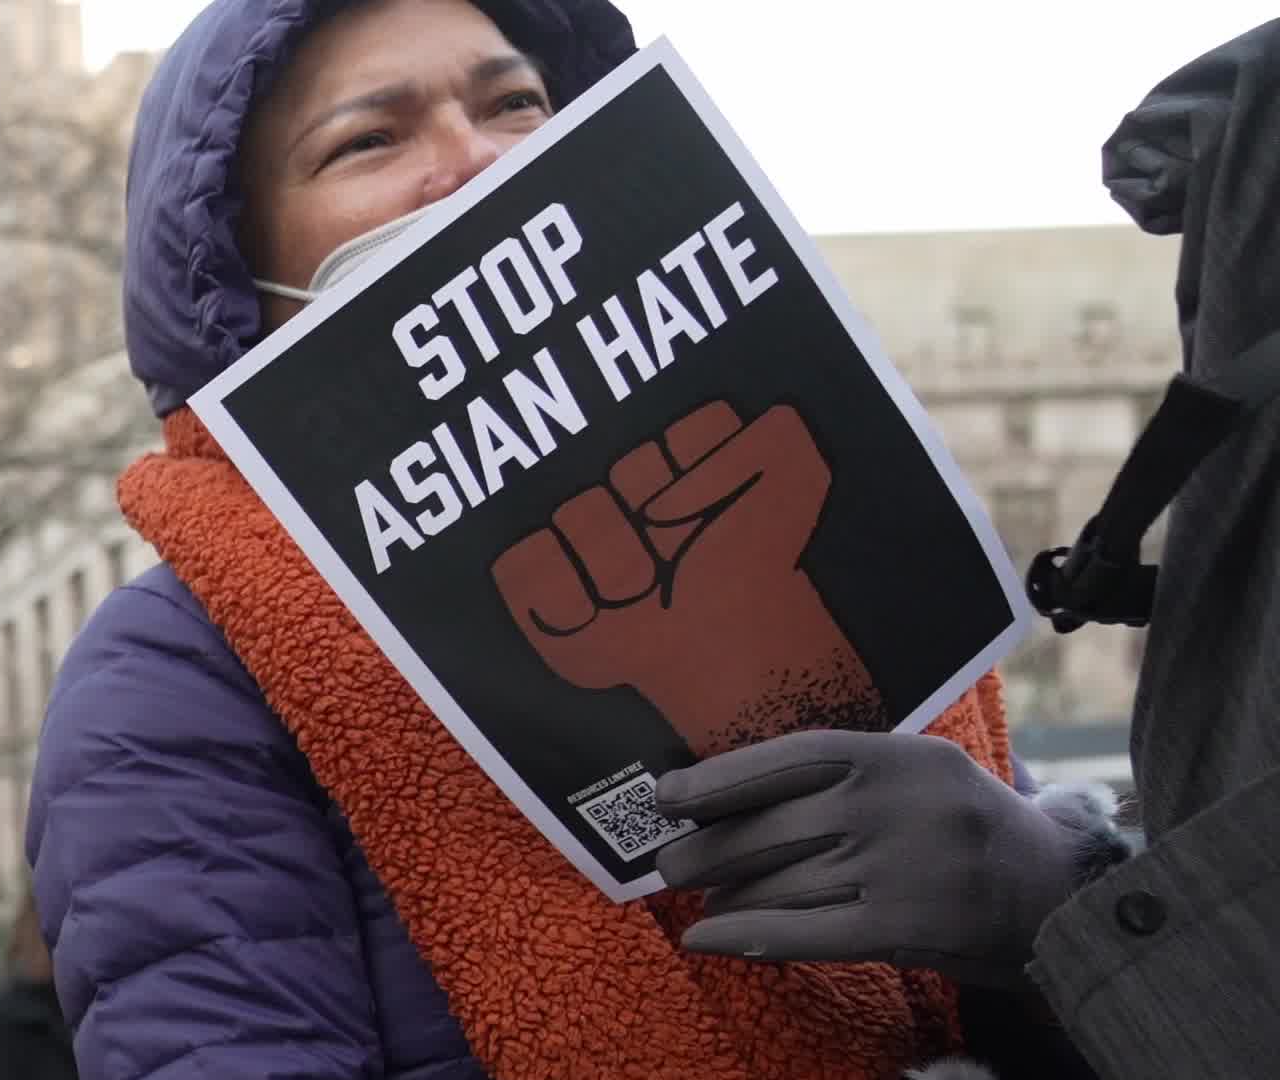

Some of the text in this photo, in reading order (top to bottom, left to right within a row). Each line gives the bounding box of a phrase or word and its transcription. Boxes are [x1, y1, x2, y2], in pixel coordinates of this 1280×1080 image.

[354, 202, 779, 574] ASIAN HATE
[392, 204, 583, 400] STOP
